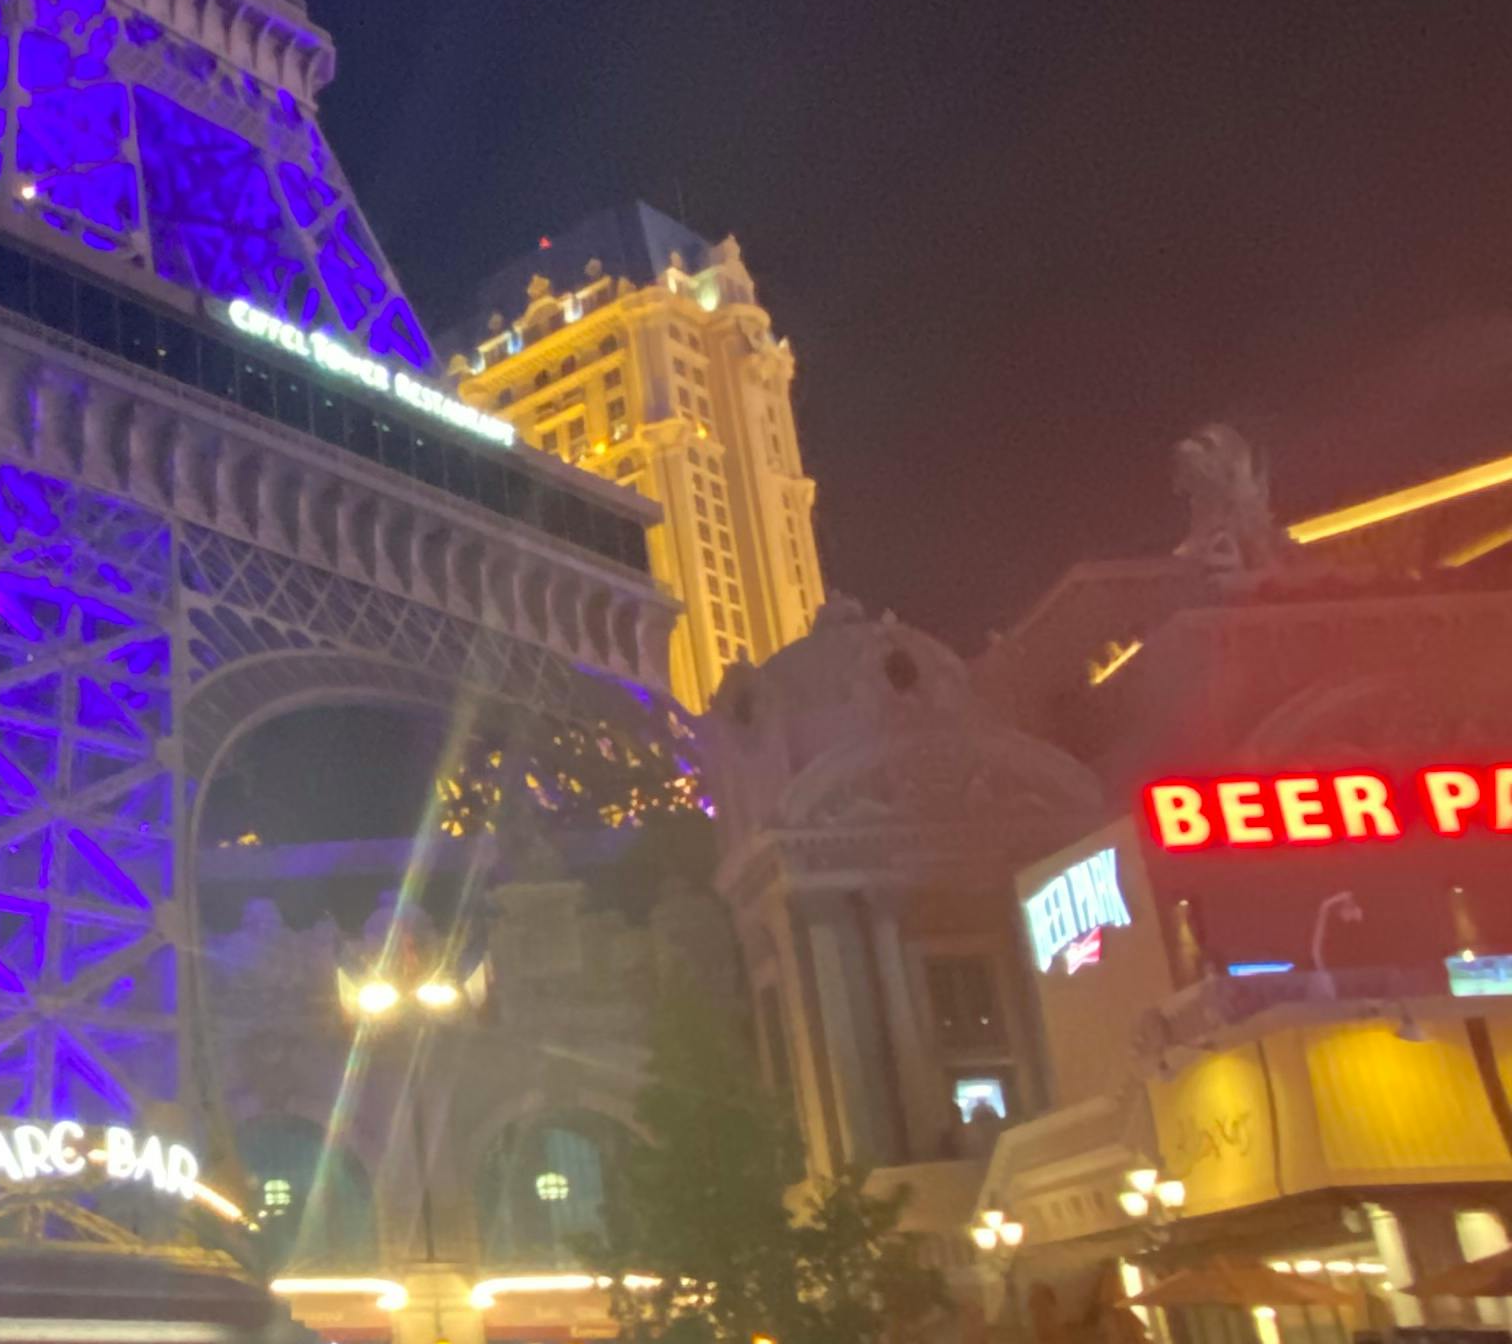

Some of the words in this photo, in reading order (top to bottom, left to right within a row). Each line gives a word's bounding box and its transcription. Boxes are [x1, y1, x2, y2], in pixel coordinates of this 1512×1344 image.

[1148, 772, 1403, 849] BEER
[1065, 847, 1132, 935] PARK
[105, 1125, 199, 1200] BAR
